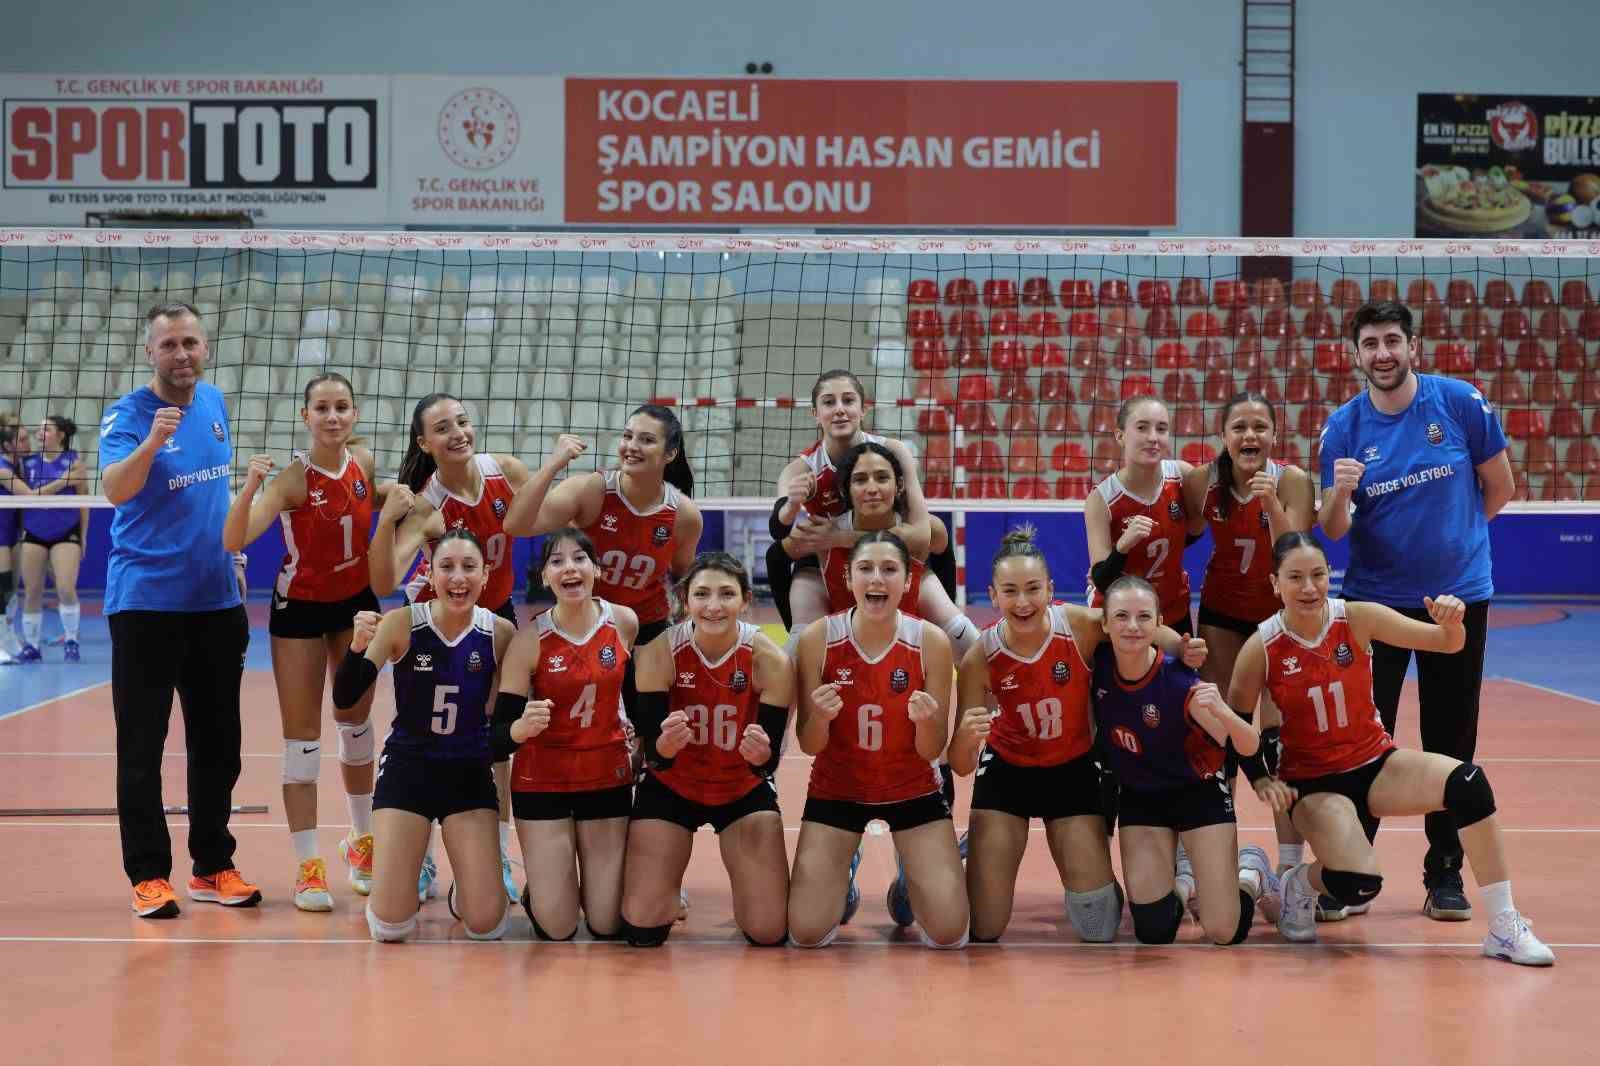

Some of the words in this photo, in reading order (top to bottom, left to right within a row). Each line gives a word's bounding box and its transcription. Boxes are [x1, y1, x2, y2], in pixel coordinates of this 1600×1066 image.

[56, 79, 84, 94] T.C.
[88, 77, 158, 96] GENÇLİK
[161, 79, 181, 94] VE
[186, 79, 230, 94] SPOR
[234, 77, 324, 94] BAKANLIĞI
[598, 83, 760, 121] KOCAELİ
[597, 128, 805, 174] ŞAMPİYON
[815, 135, 953, 168] HASAN
[962, 129, 1100, 168] GEMİCİ
[49, 193, 65, 204] BU
[103, 193, 134, 204] SPOR
[137, 193, 167, 204] TOTO
[411, 197, 454, 211] SPOR
[458, 195, 545, 211] BAKANLIĞI
[418, 178, 444, 192] T.C.
[448, 177, 515, 195] GENÇLİK
[519, 178, 539, 192] VE
[597, 179, 702, 212] SPOR
[711, 180, 871, 212] SALONU
[1366, 479, 1400, 497] DÜZCE
[1400, 463, 1454, 488] VOLEYBOL
[339, 515, 353, 559] 1
[1234, 538, 1256, 574] 7
[601, 550, 656, 590] 33
[1146, 538, 1169, 578] 2
[431, 685, 459, 735] 5
[569, 683, 597, 728] 4
[1016, 697, 1063, 740] 18
[1307, 680, 1349, 733] 11
[684, 704, 738, 751] 36
[857, 703, 883, 752] 6
[1115, 728, 1138, 753] 10
